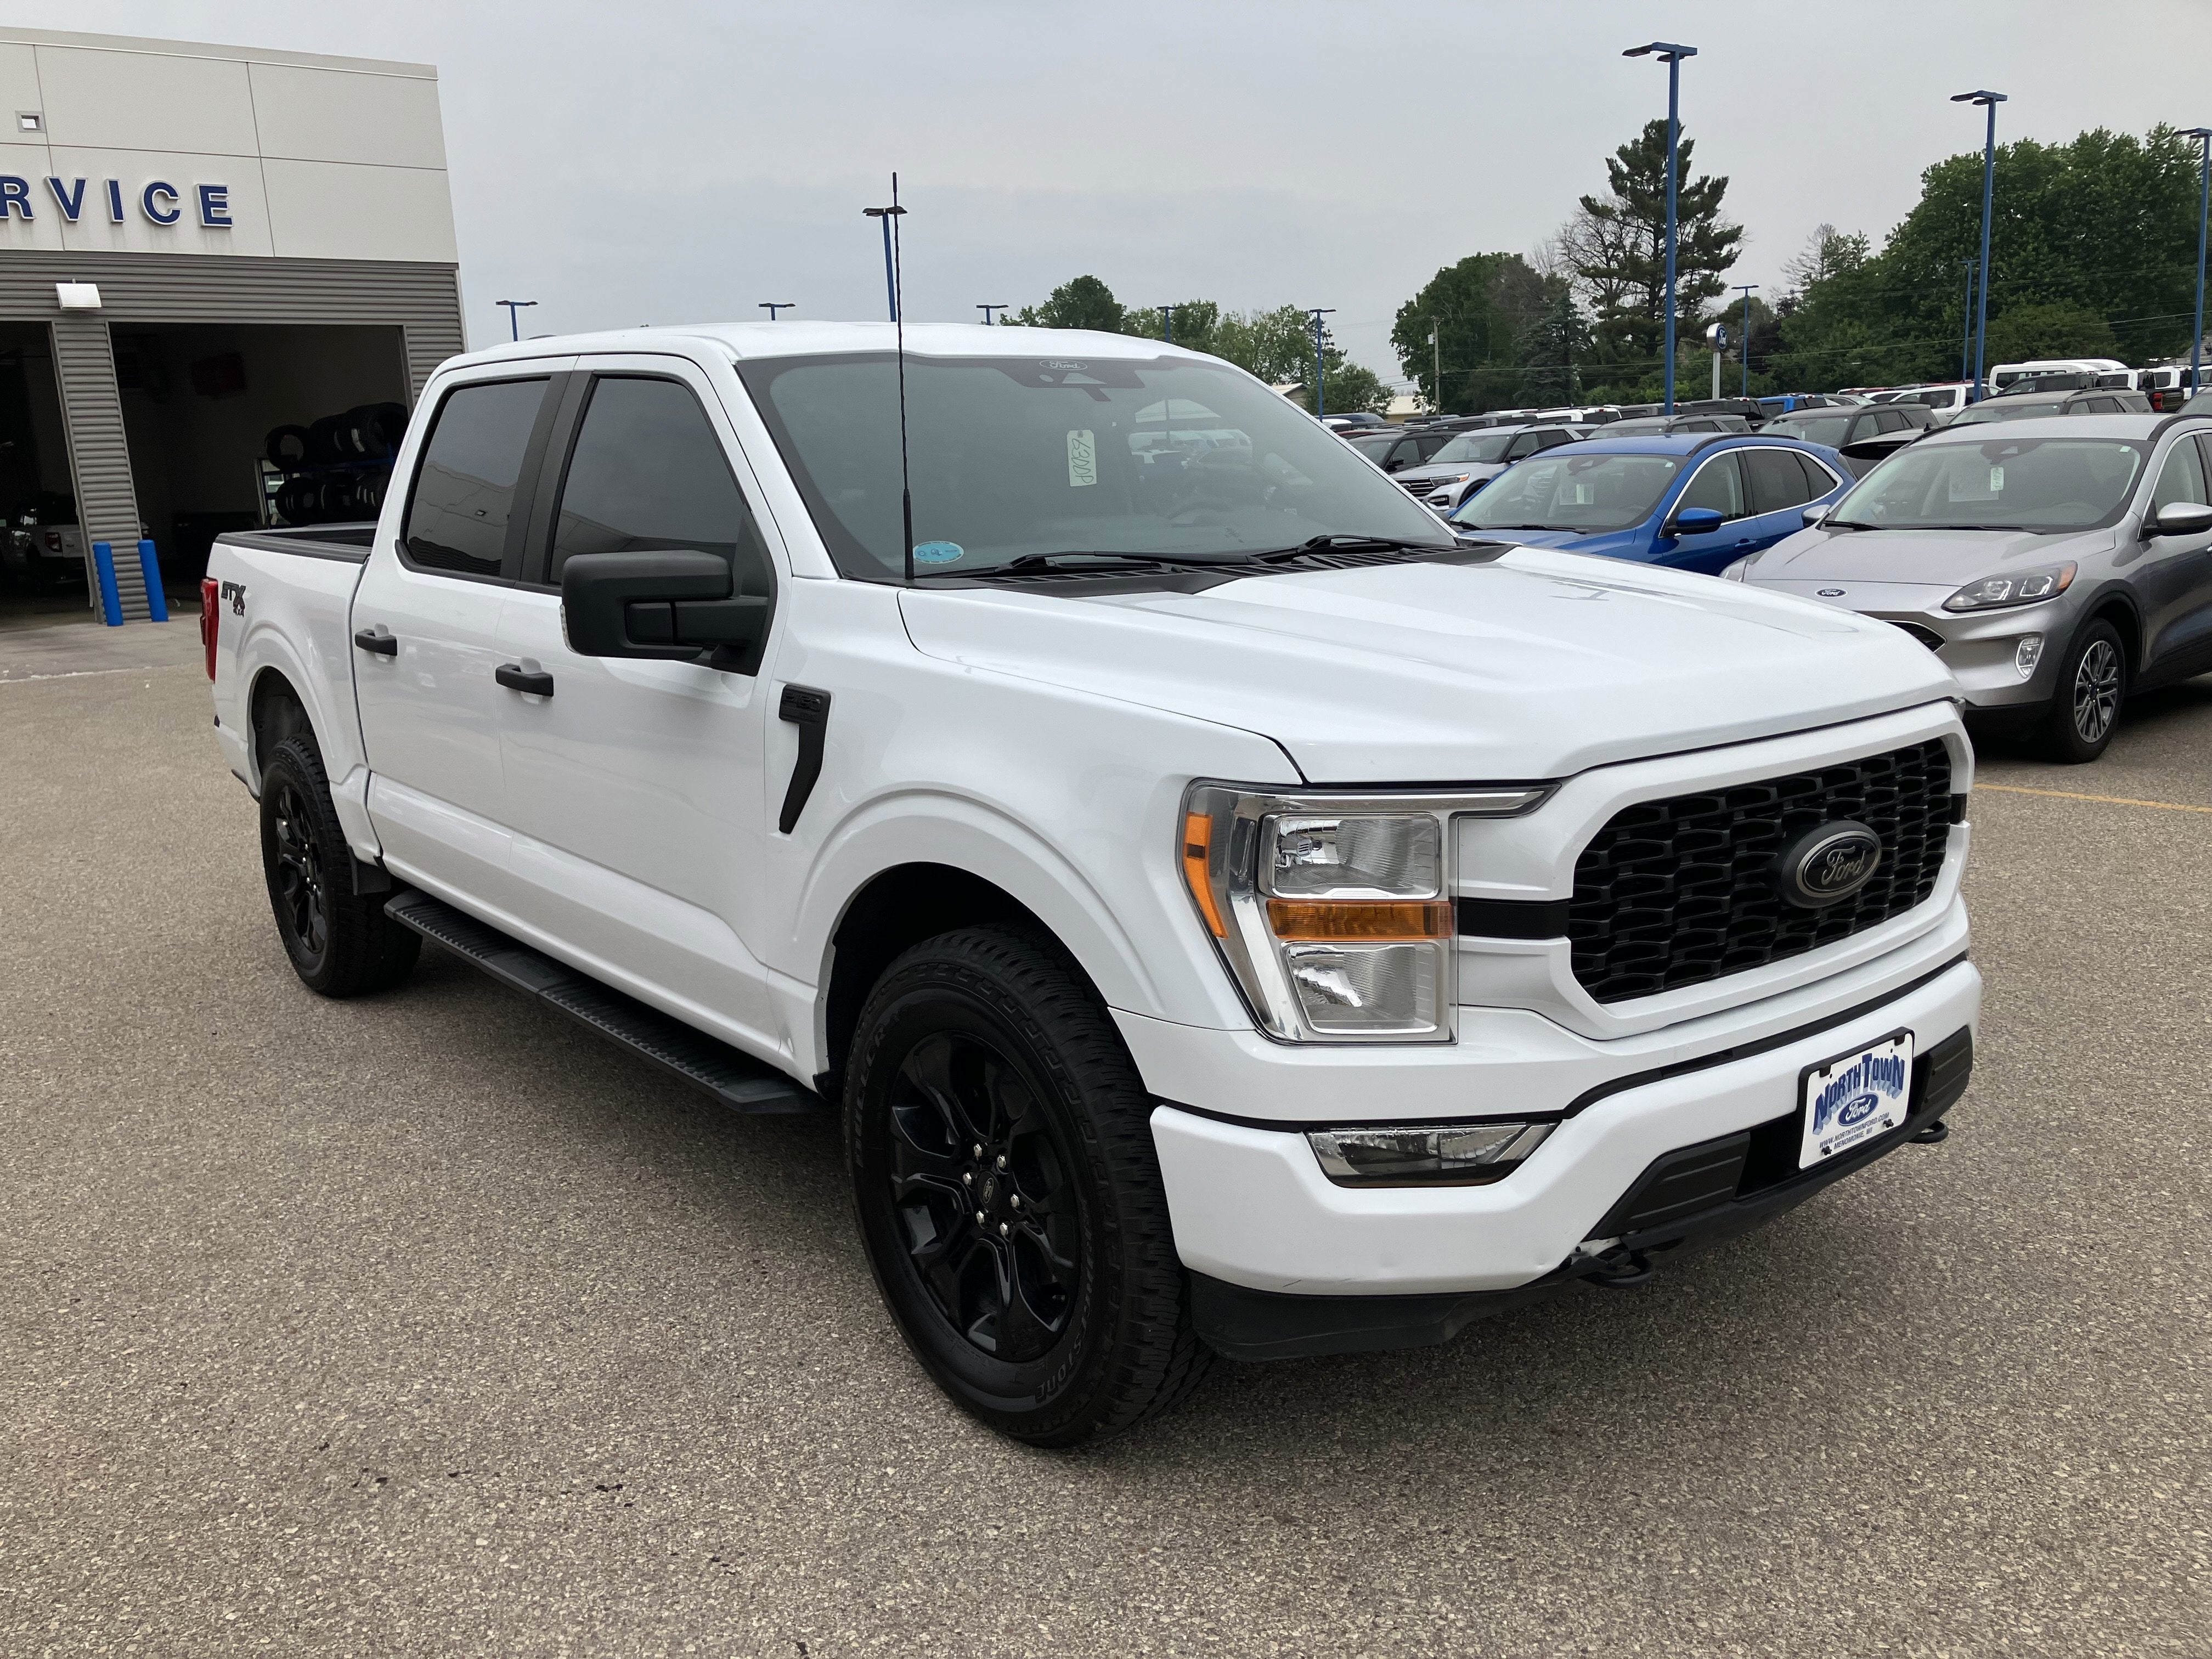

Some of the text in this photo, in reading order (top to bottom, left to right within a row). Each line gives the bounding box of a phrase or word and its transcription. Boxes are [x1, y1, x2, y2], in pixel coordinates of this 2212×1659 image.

[1049, 360, 1081, 369] Ford
[221, 580, 246, 610] STX
[1821, 845, 1866, 886] Ford
[1845, 1097, 1871, 1122] Ford
[1819, 1111, 1889, 1149] WWW.NORTHTOWNFORD.COM
